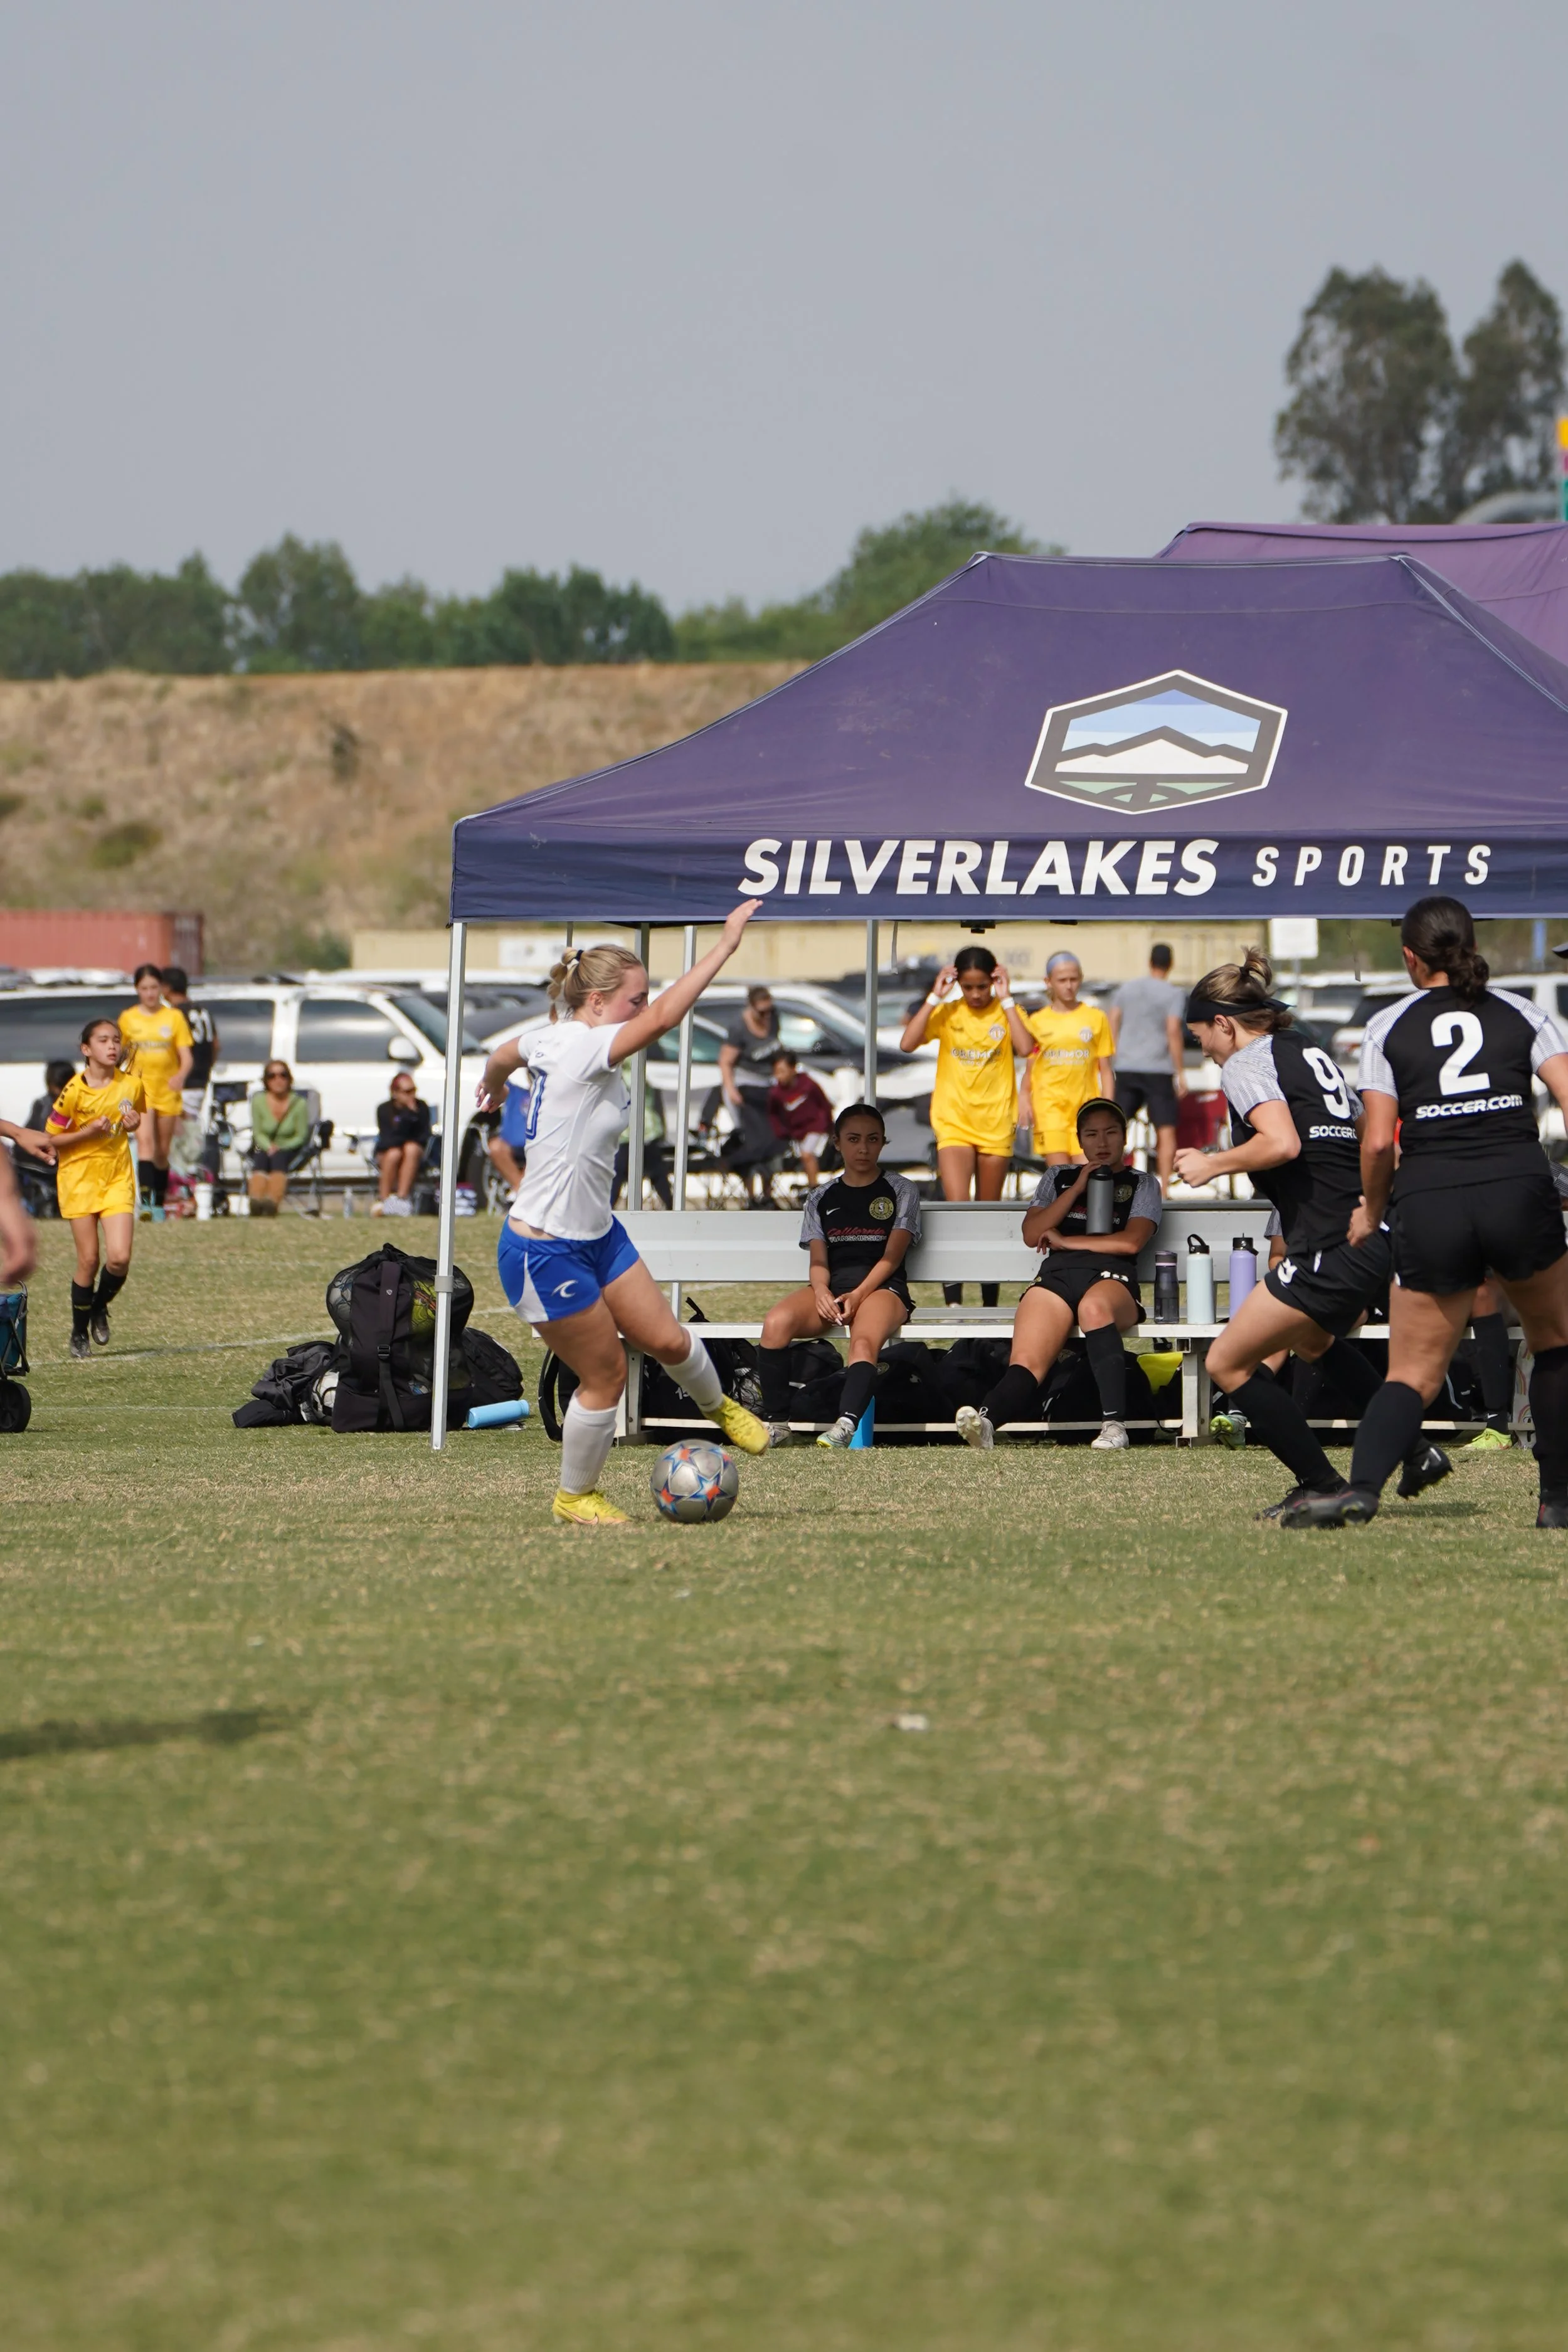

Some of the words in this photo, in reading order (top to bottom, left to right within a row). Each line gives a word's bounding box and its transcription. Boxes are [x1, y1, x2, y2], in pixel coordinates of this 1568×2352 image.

[738, 838, 1220, 896] SILVERLAKES
[1253, 845, 1491, 886] SPORTS
[189, 1009, 214, 1044] 31
[1431, 1010, 1491, 1096] 2
[1302, 1047, 1351, 1119] 9
[1415, 1094, 1523, 1119] SOCCER.COM
